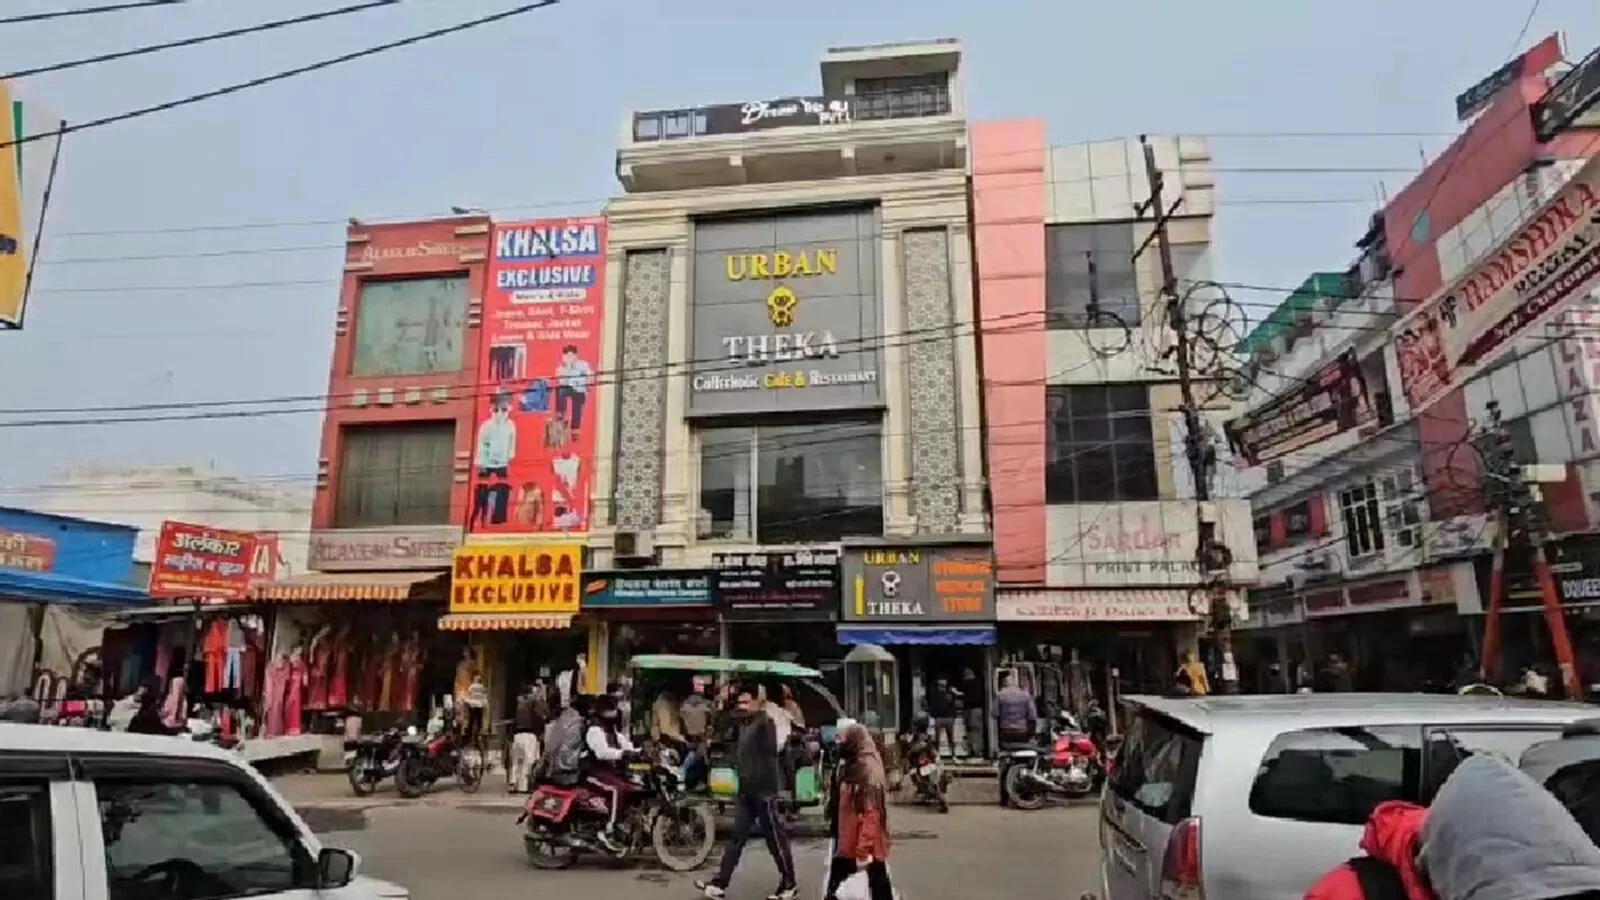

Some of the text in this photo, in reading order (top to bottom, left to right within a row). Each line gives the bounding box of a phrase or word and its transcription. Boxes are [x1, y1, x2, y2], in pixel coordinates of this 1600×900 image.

[496, 224, 599, 258] KHALSA
[496, 264, 594, 288] EXCLUSIVE
[726, 249, 838, 281] URBAN
[721, 329, 840, 364] THEKA
[454, 553, 575, 580] KHALSA
[864, 551, 921, 566] URBAN
[1095, 561, 1142, 575] PRINT
[453, 582, 576, 605] EXCLUSIVE
[867, 601, 925, 616] THEKA
